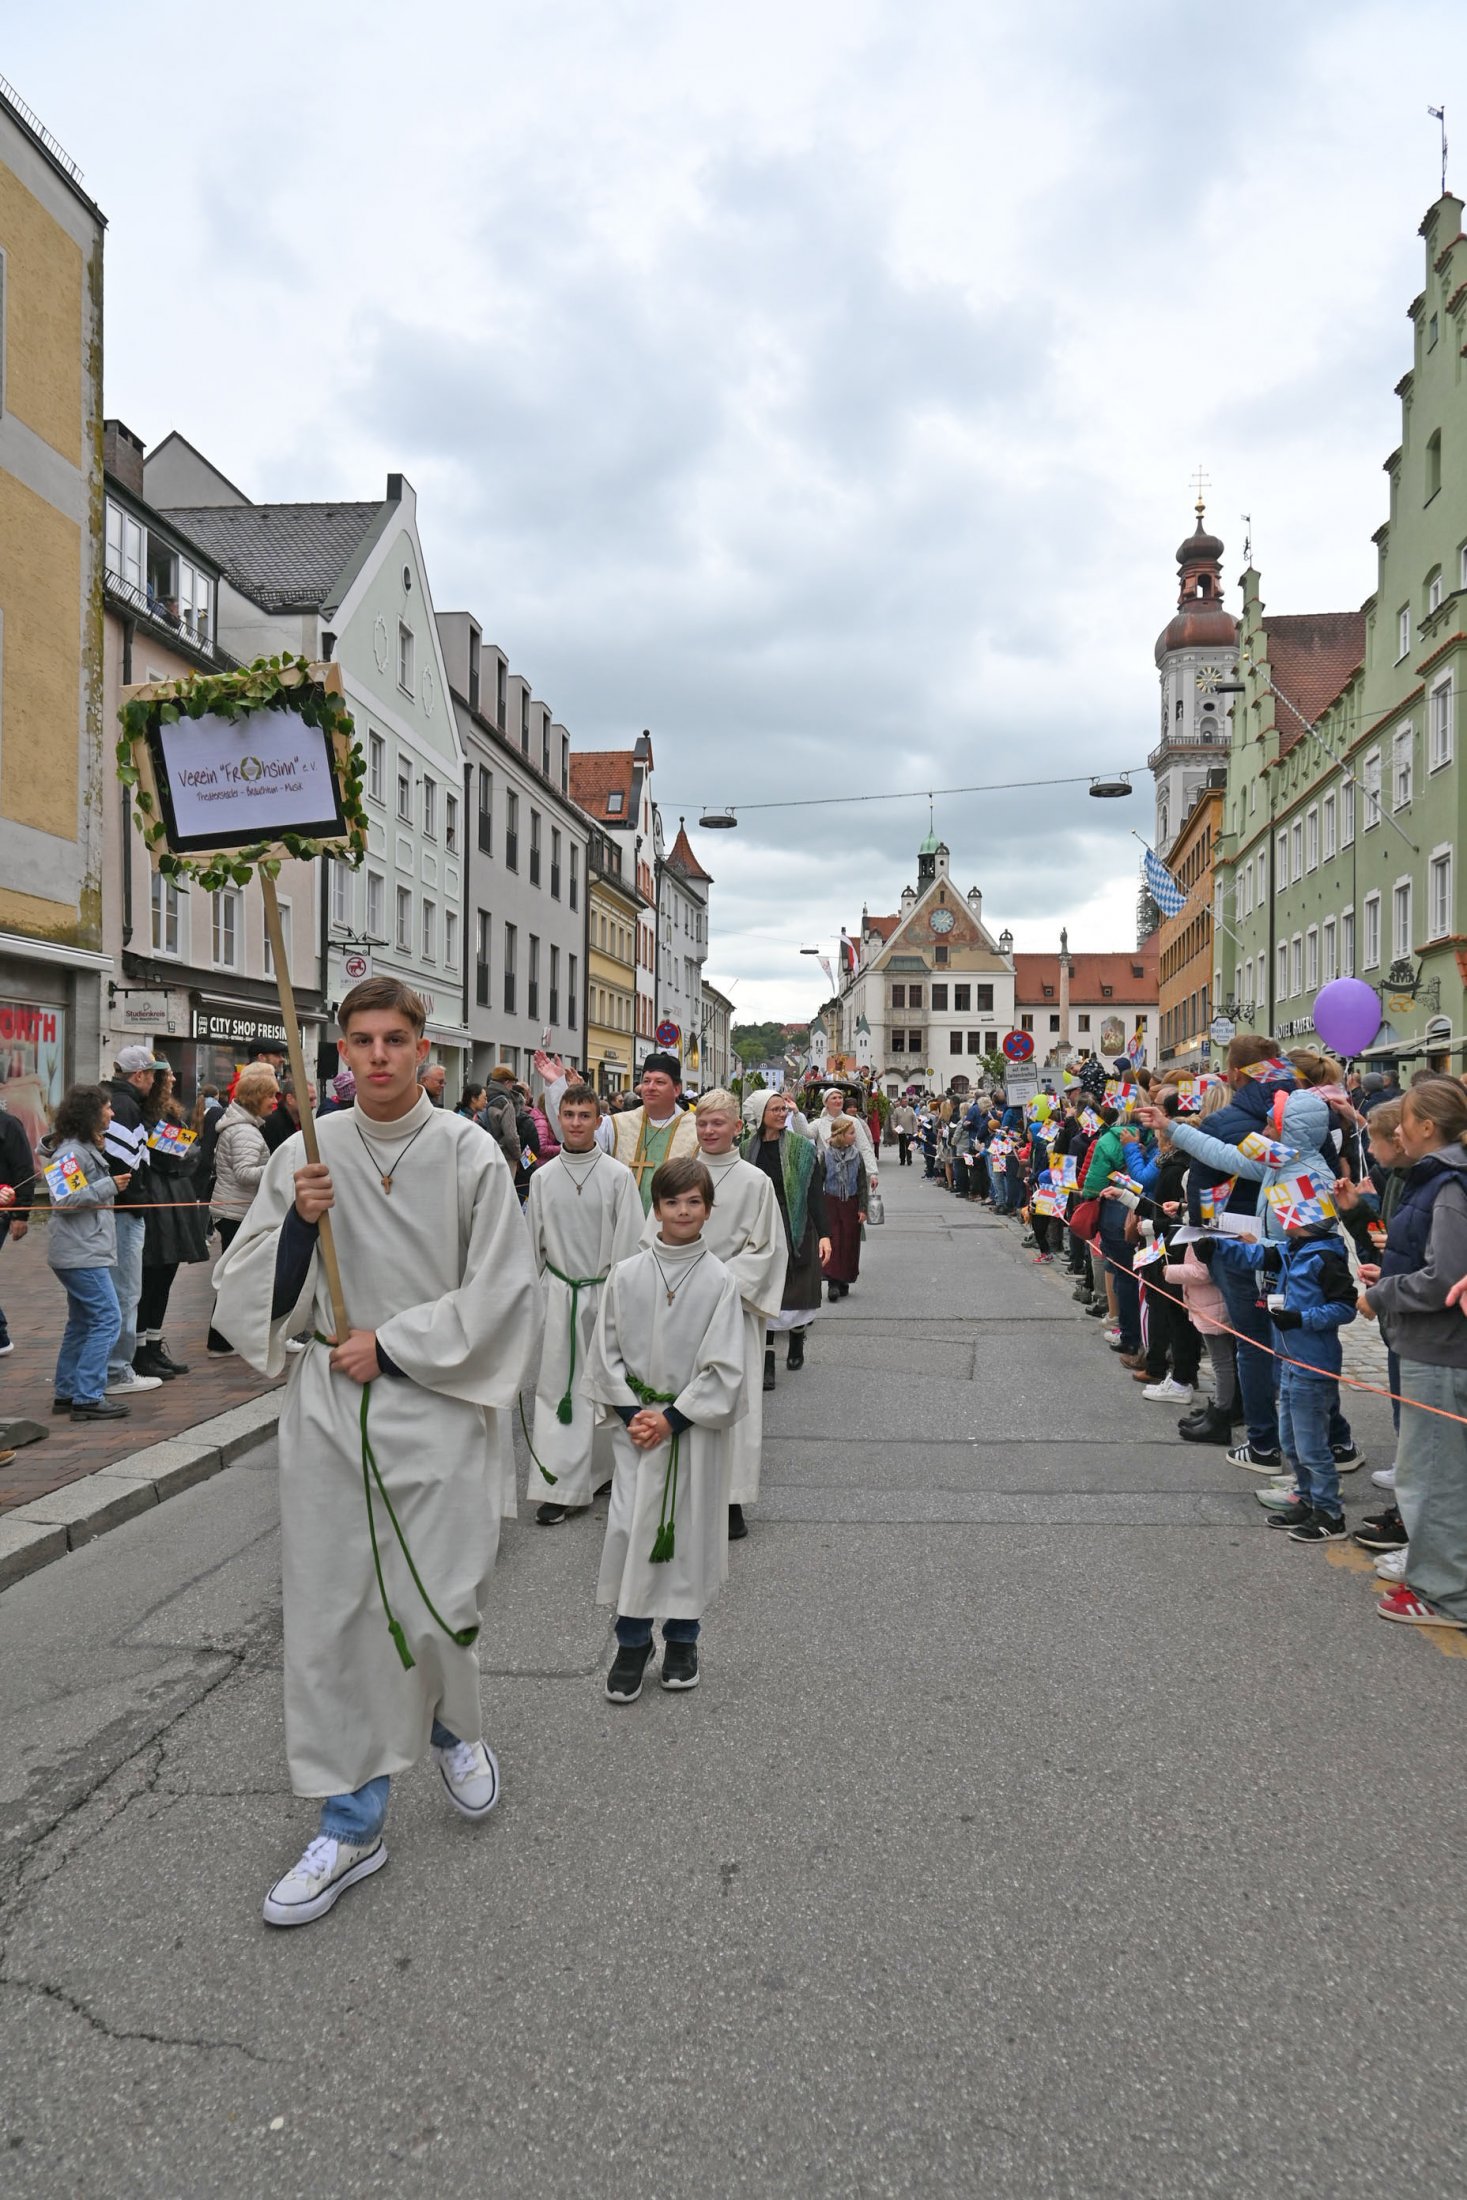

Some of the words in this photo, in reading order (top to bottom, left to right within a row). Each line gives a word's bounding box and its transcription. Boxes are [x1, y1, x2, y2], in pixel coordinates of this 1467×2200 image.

[126, 1010, 165, 1018] Studienkreis
[210, 1016, 230, 1034] CITY
[232, 1019, 256, 1036] SHOP
[257, 1023, 288, 1041] FREISIN
